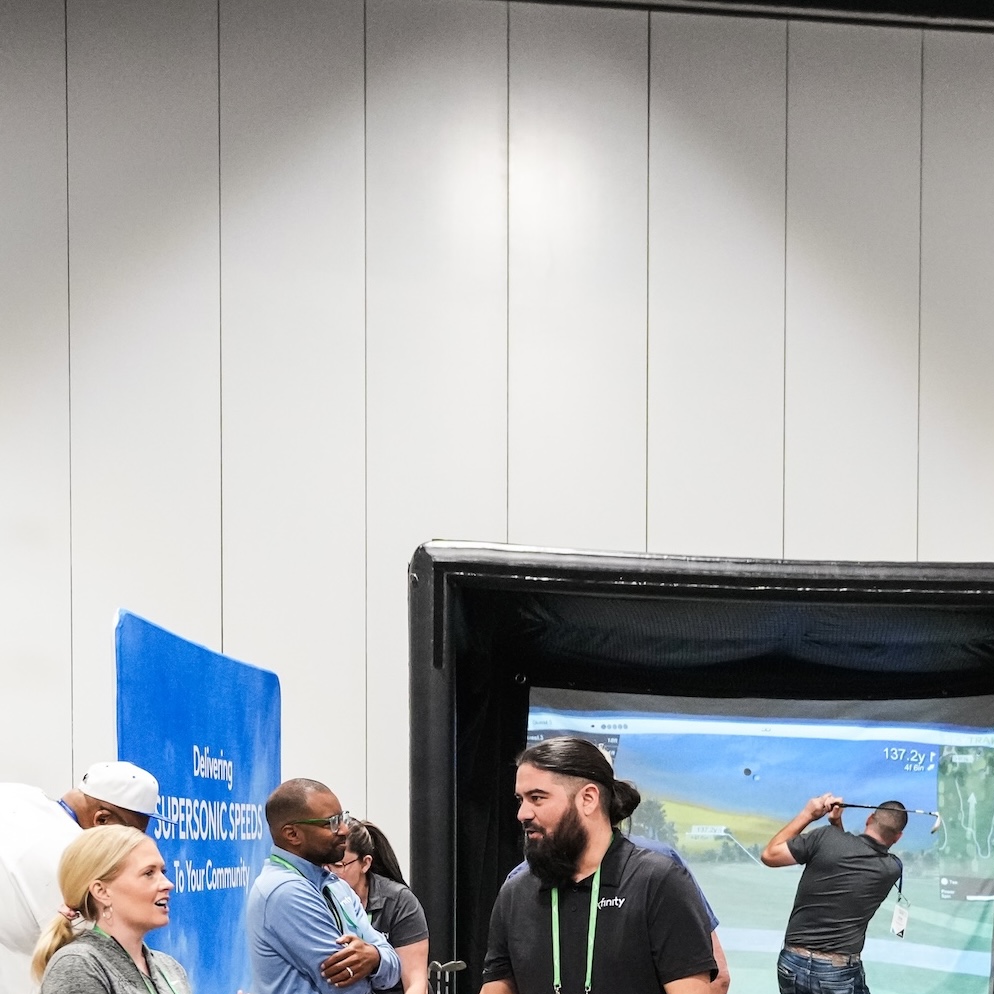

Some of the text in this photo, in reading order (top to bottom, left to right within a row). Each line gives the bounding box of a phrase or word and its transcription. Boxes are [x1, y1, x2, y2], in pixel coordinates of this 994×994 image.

[193, 744, 233, 790] Delivering
[883, 747, 926, 764] 137.2y
[154, 795, 263, 841] SUPERSONIC SPEEDS
[174, 857, 250, 894] To Your Community
